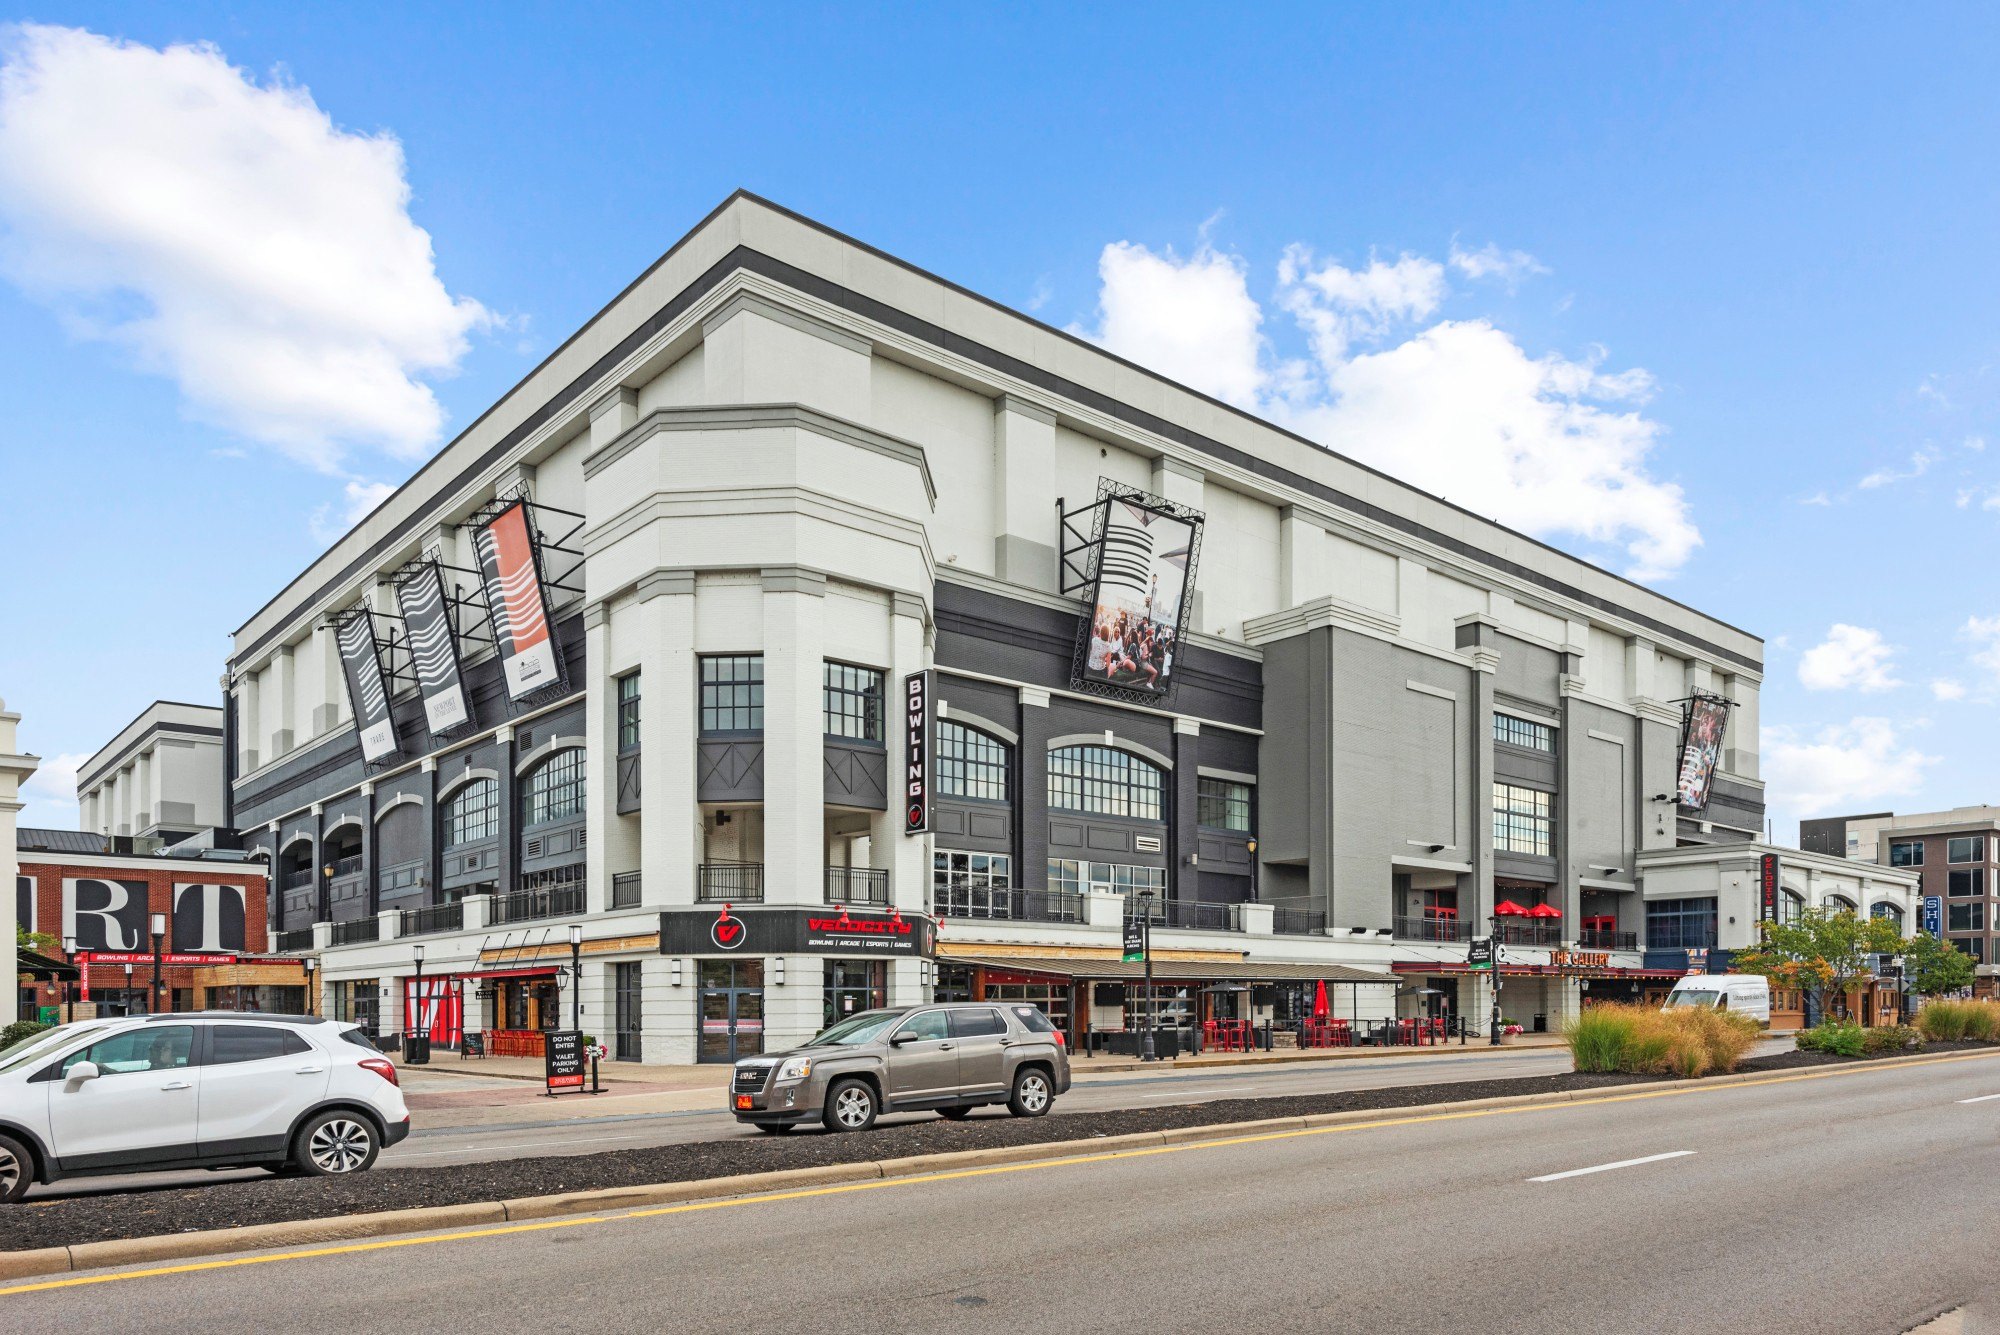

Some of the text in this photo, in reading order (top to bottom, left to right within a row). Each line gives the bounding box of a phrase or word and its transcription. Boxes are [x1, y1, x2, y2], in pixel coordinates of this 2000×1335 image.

[909, 680, 923, 796] BOWLING
[17, 876, 246, 952] RT
[808, 918, 912, 934] VELOCITY
[1551, 951, 1610, 965] THE GALLERY
